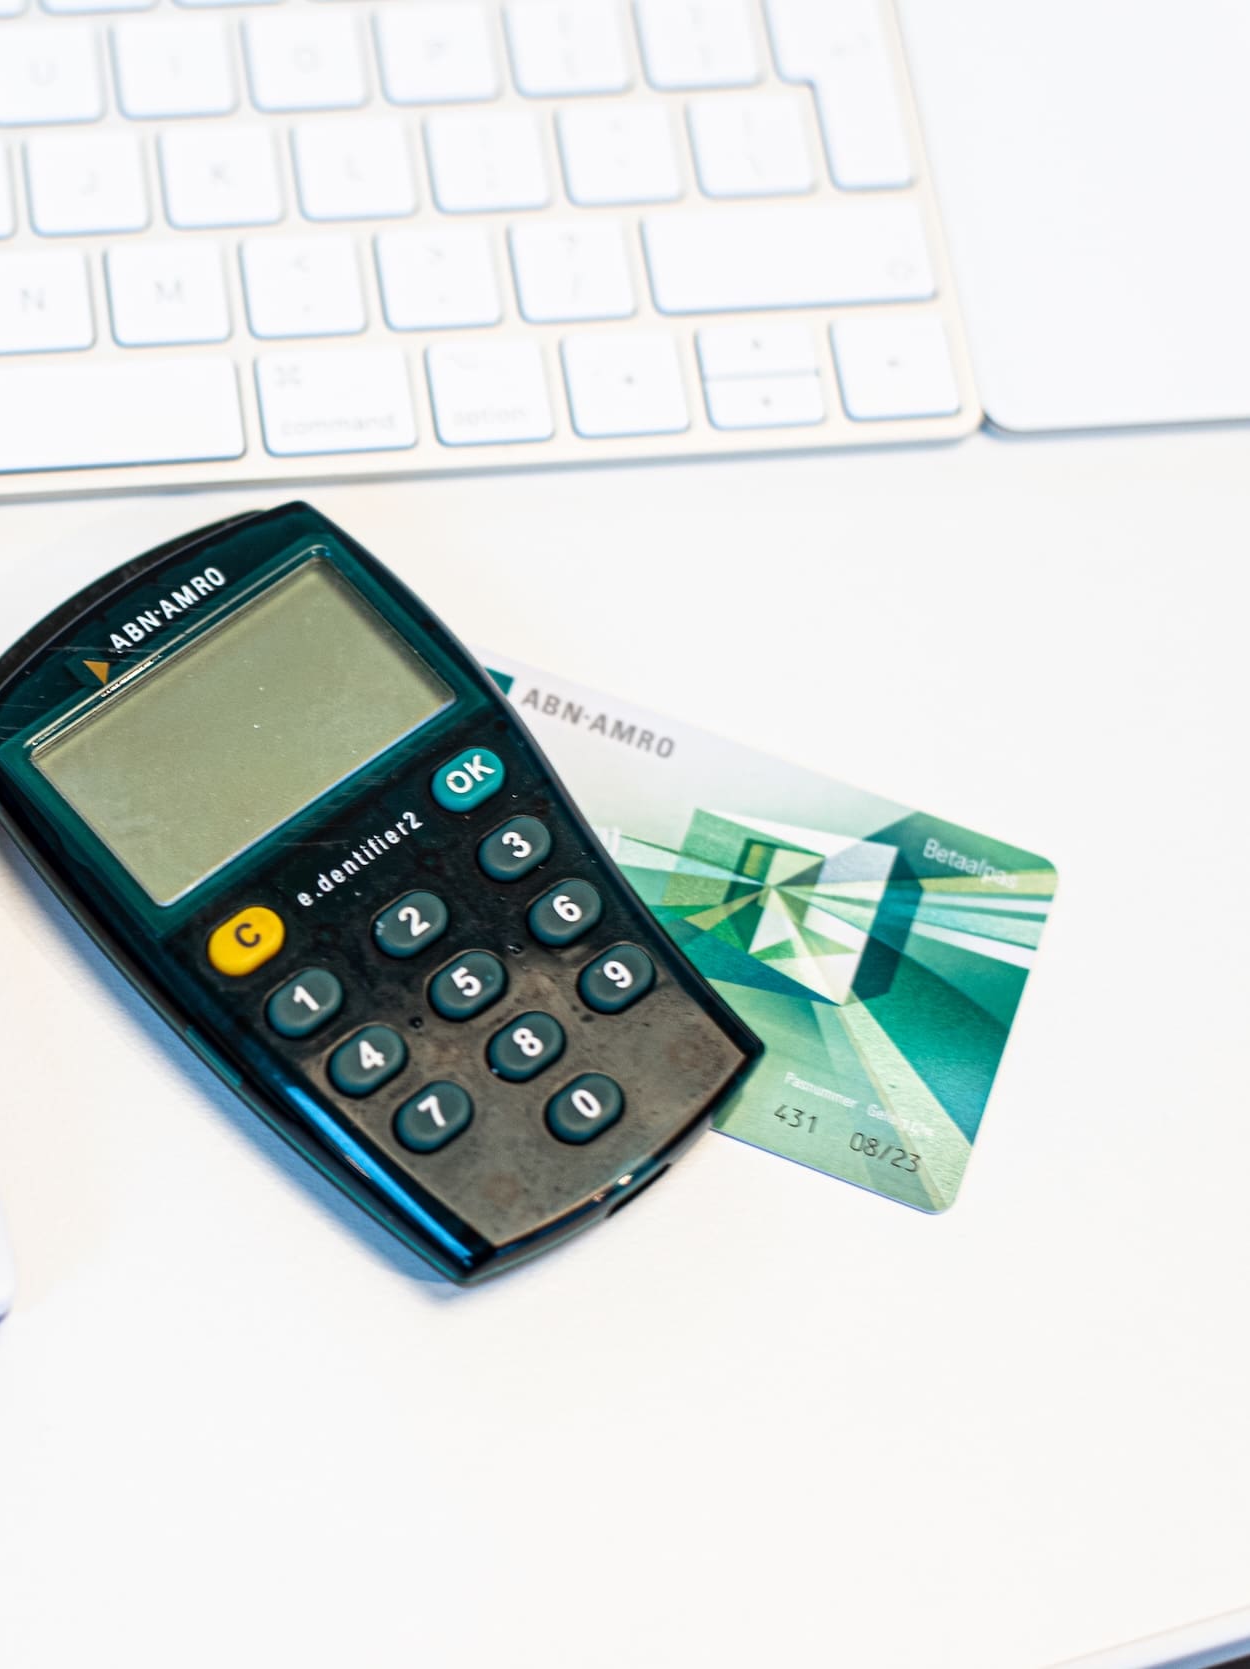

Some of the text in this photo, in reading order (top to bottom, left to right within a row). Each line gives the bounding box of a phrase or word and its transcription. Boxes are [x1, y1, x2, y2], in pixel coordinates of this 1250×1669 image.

[27, 57, 59, 89] U
[290, 43, 323, 76] O
[79, 168, 101, 197] J
[207, 159, 232, 189] K
[19, 286, 47, 314] N
[153, 277, 185, 306] M
[282, 414, 395, 435] command
[446, 754, 495, 794] OK
[297, 811, 424, 907] e.dentifier2
[501, 831, 532, 858] 3
[922, 838, 1018, 889] Betaalpas
[397, 906, 431, 937] 2
[552, 895, 583, 922] 6
[235, 922, 262, 949] C
[451, 966, 482, 997] 5
[603, 960, 633, 989] 9
[293, 985, 320, 1012] 1
[359, 1040, 386, 1070] 4
[512, 1027, 544, 1057] 8
[417, 1095, 447, 1127] 7
[571, 1089, 602, 1119] 0
[774, 1104, 818, 1134] 431
[849, 1132, 921, 1174] 08/23
